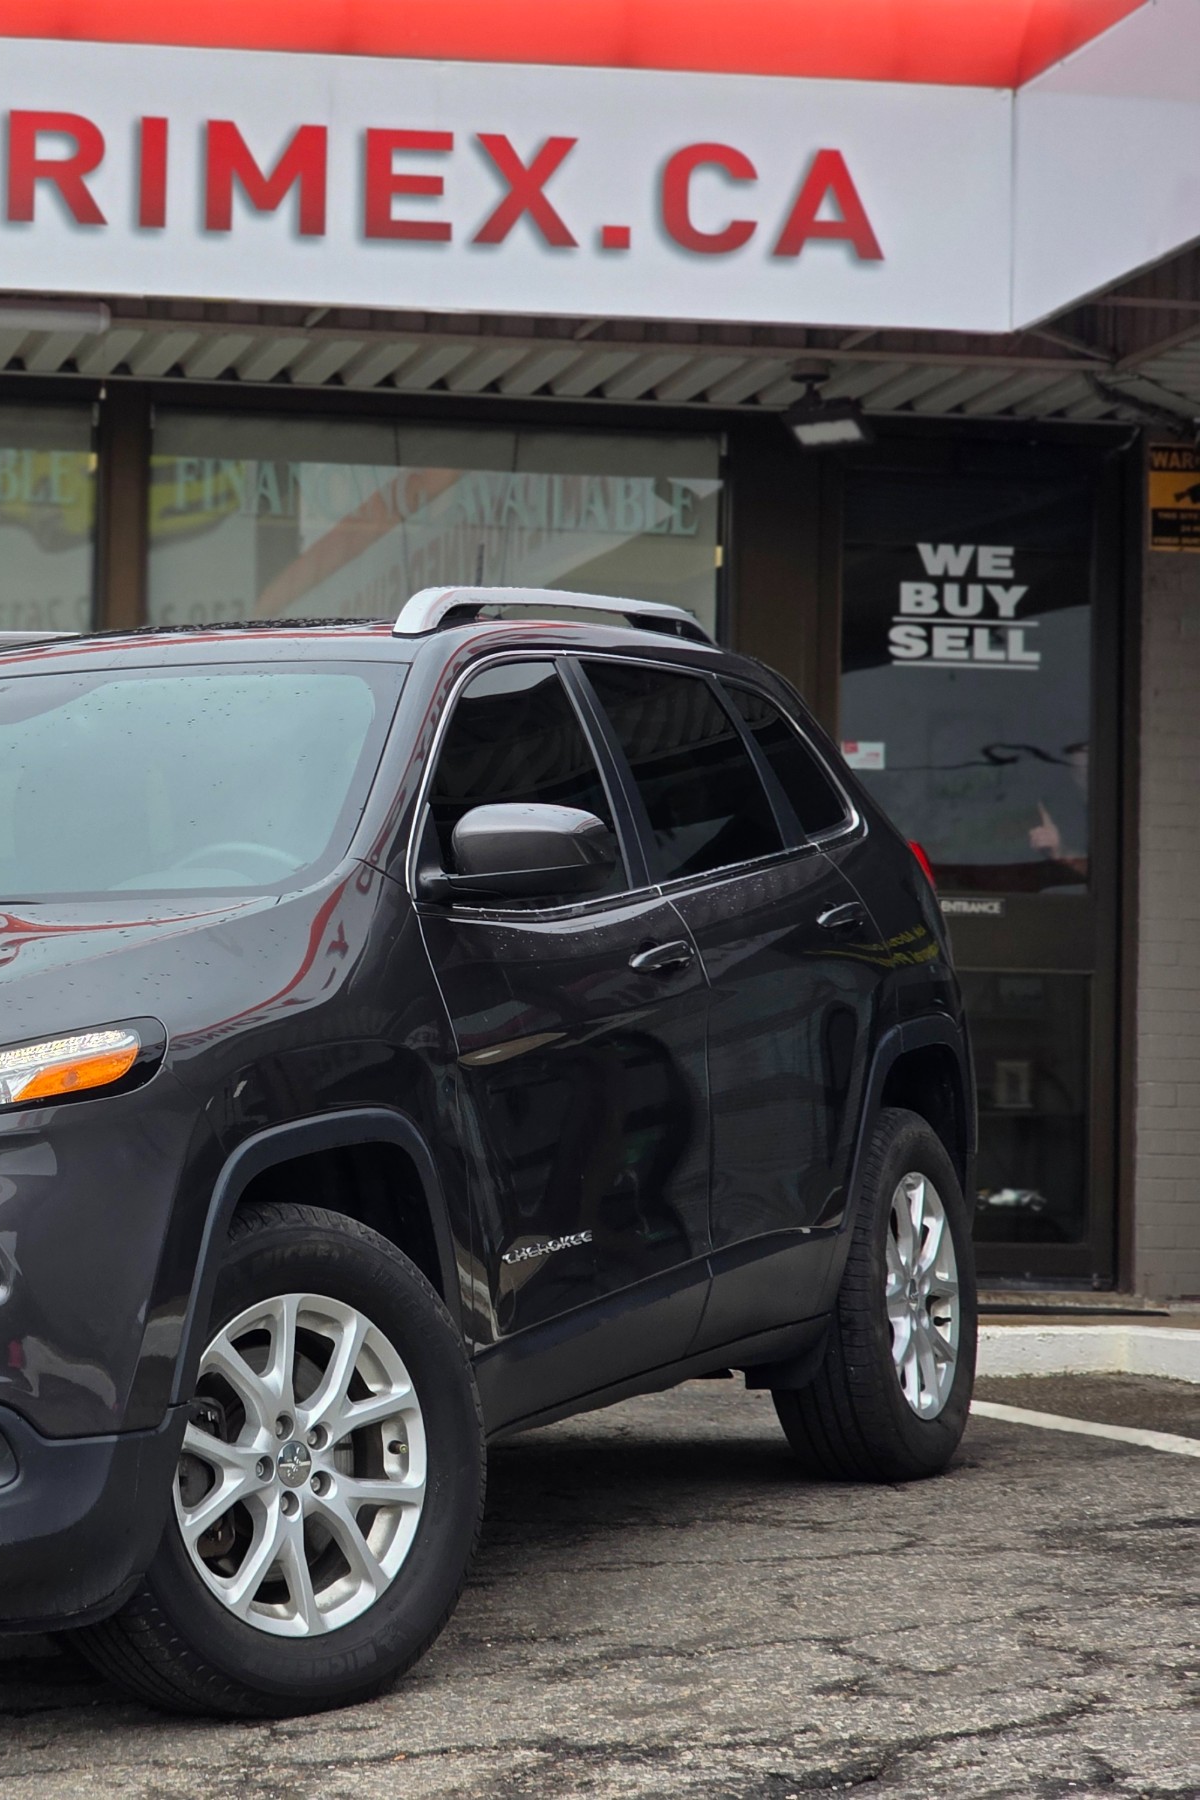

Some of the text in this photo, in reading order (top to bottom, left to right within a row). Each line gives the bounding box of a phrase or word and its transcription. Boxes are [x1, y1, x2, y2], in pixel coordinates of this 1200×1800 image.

[915, 542, 1015, 579] WE
[900, 581, 1030, 619] BUY
[887, 624, 1042, 662] SELL
[940, 900, 1001, 914] ENTRANCE
